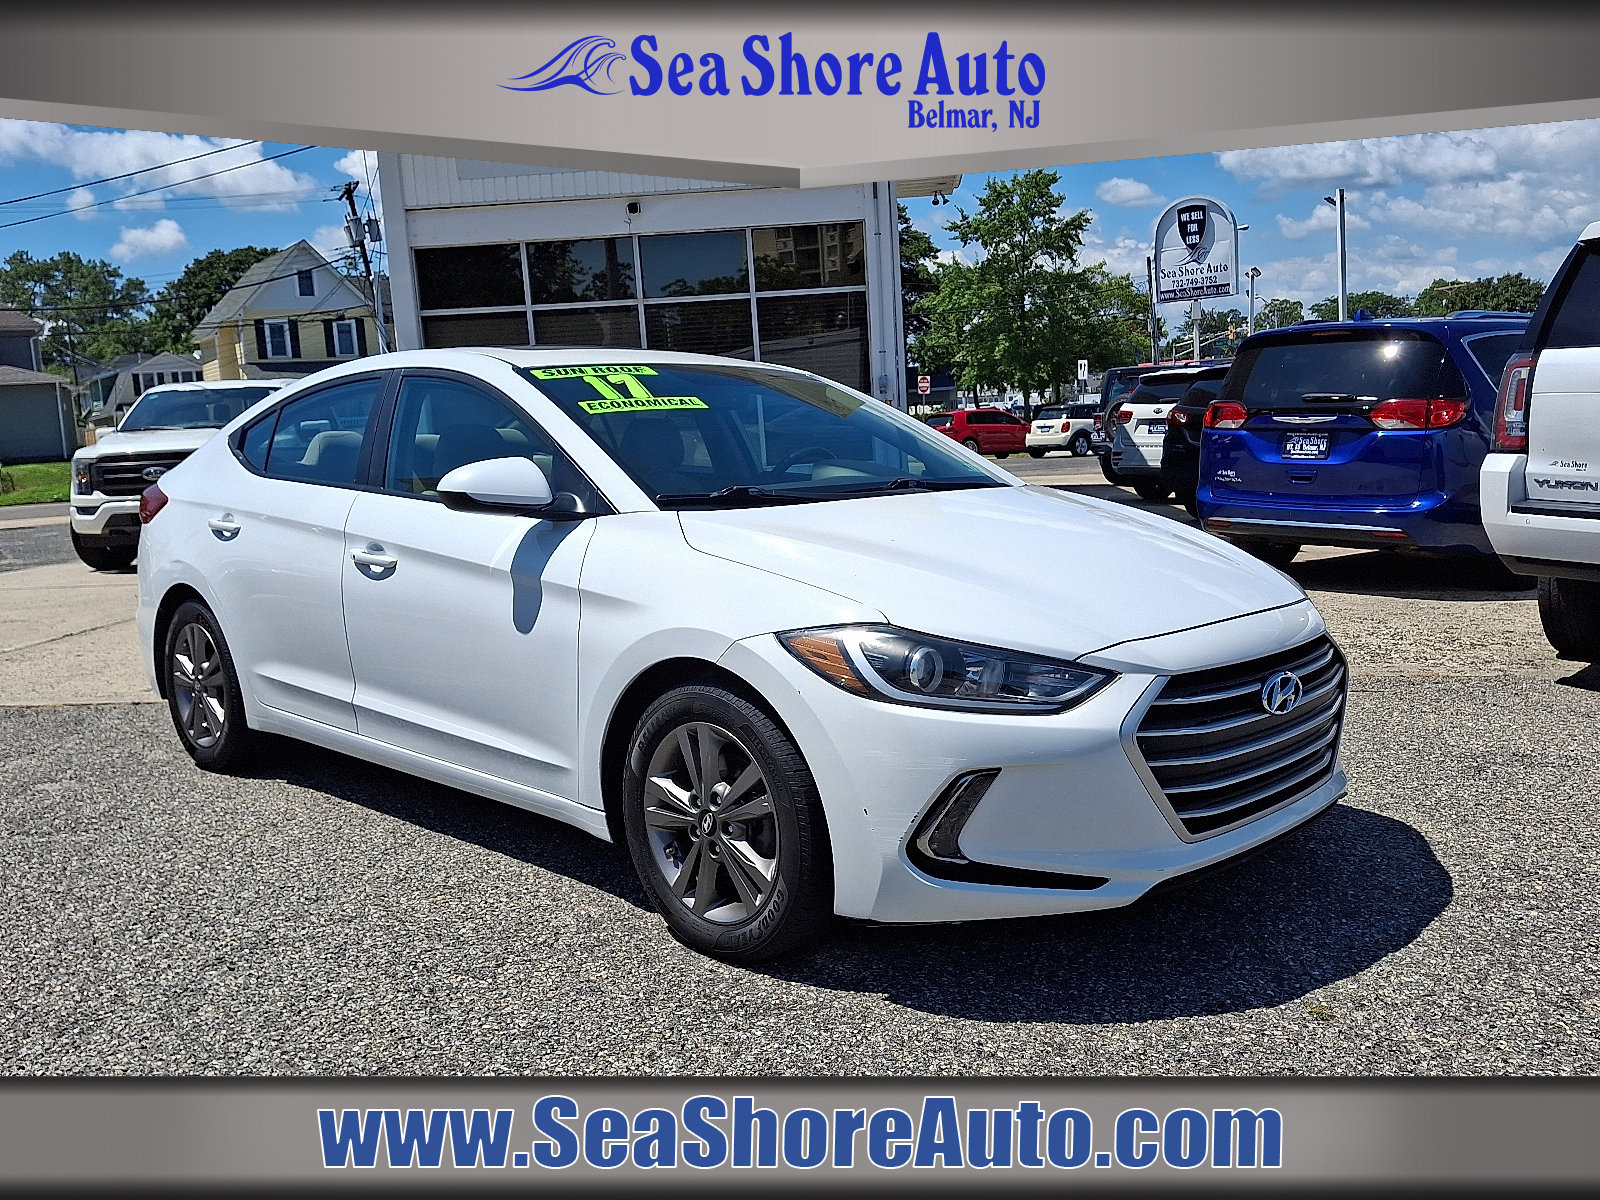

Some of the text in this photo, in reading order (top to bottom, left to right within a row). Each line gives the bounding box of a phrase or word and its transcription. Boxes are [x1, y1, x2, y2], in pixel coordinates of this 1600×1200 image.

[1181, 211, 1203, 222] WE SELL
[1187, 224, 1198, 232] FOR
[1186, 235, 1199, 244] LESS
[1161, 263, 1228, 279] Sea Shore Auto
[1172, 275, 1217, 288] 732-749-3752
[542, 365, 646, 376] SUN ROOF
[583, 374, 654, 400] 17
[586, 398, 701, 410] ECONOMICAL
[1534, 478, 1599, 491] YUKON
